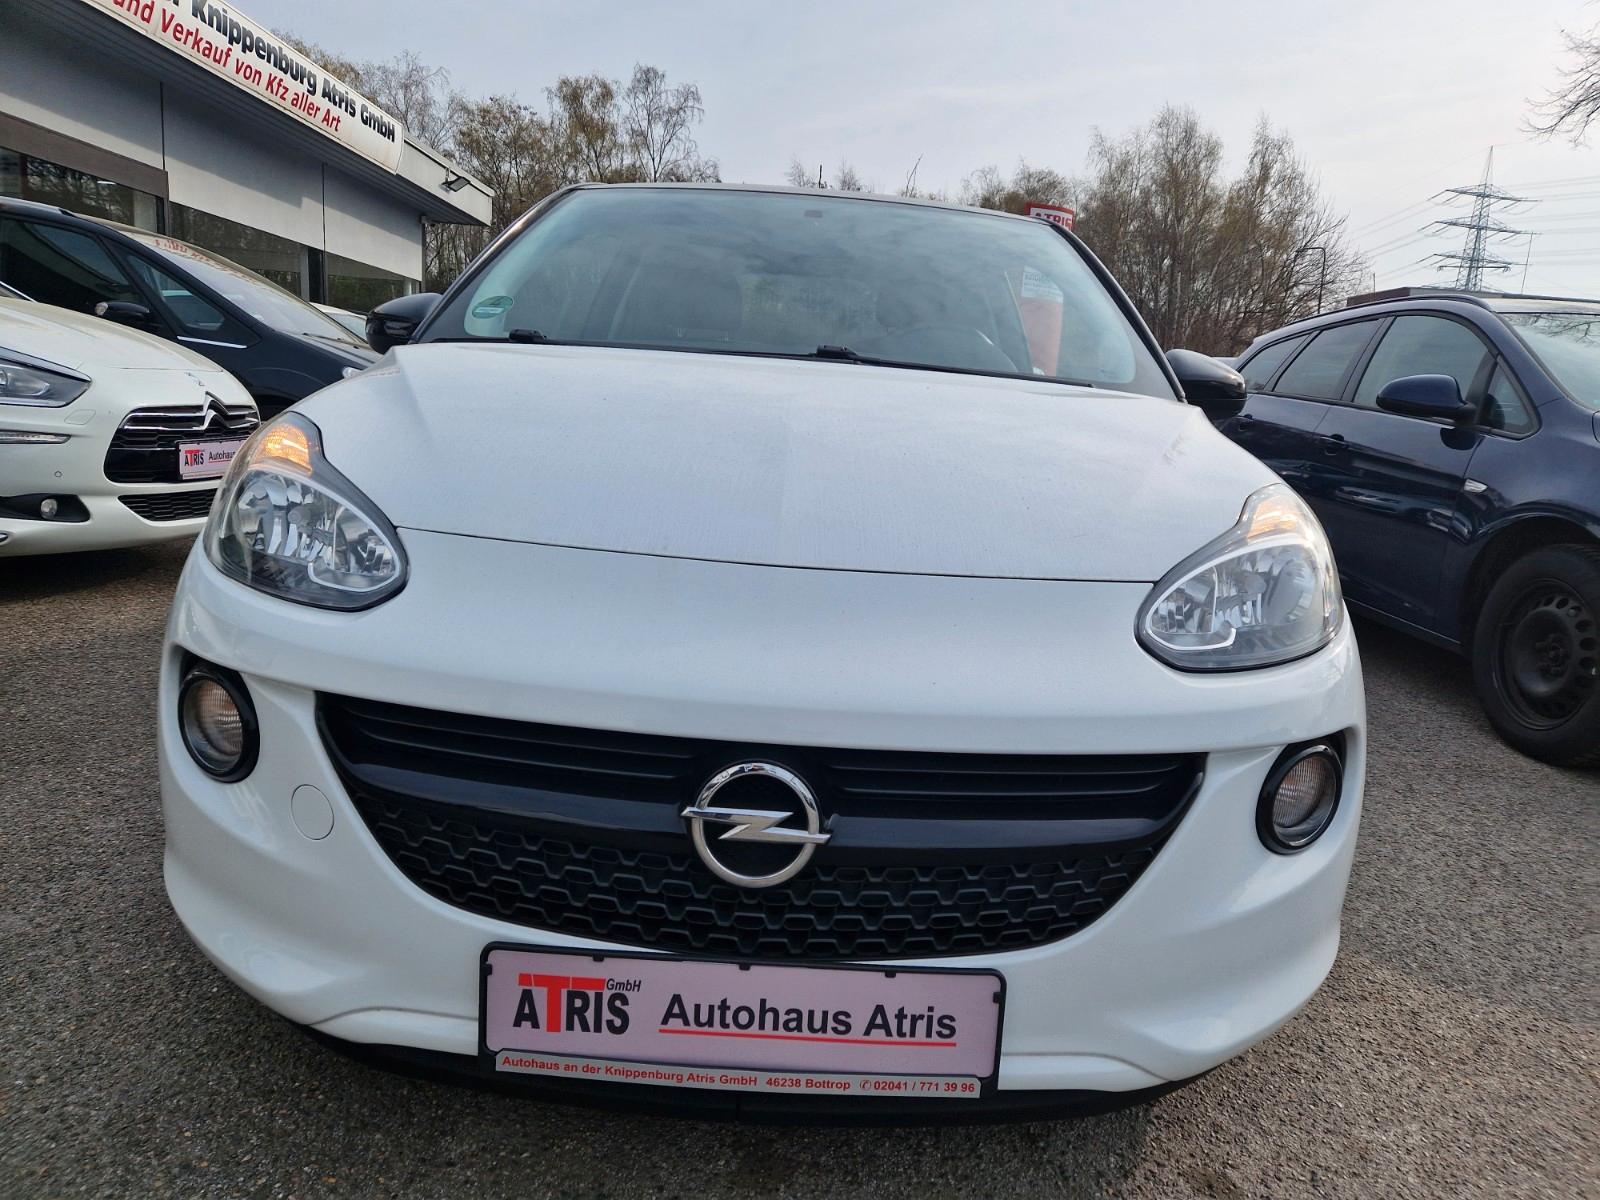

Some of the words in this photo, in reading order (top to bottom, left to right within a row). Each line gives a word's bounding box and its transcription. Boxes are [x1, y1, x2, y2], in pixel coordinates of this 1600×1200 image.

[161, 7, 233, 68] Verkauf
[234, 57, 262, 86] von
[265, 72, 289, 102] Kfz
[291, 91, 320, 119] aller
[321, 108, 342, 132] Art
[191, 0, 317, 96] Knippenburg
[321, 77, 357, 118] Atris
[360, 103, 396, 143] GmbH
[184, 449, 205, 467] ATRIS
[512, 973, 630, 1035] ATRIS
[606, 978, 642, 993] GmbH
[660, 993, 852, 1036] Autohaus
[863, 1004, 957, 1039] Atris
[502, 1056, 560, 1071] Autohaus
[563, 1063, 578, 1073] an
[581, 1062, 601, 1075] der
[604, 1065, 684, 1084] Knippenburg
[686, 1072, 716, 1084] Atris
[719, 1074, 757, 1088] GmbH
[766, 1077, 801, 1088] 46238
[805, 1079, 851, 1090] Bottrop
[873, 1081, 908, 1092] 02041
[919, 1082, 939, 1092] 771
[943, 1082, 958, 1093] 39
[960, 1083, 976, 1093] 96
